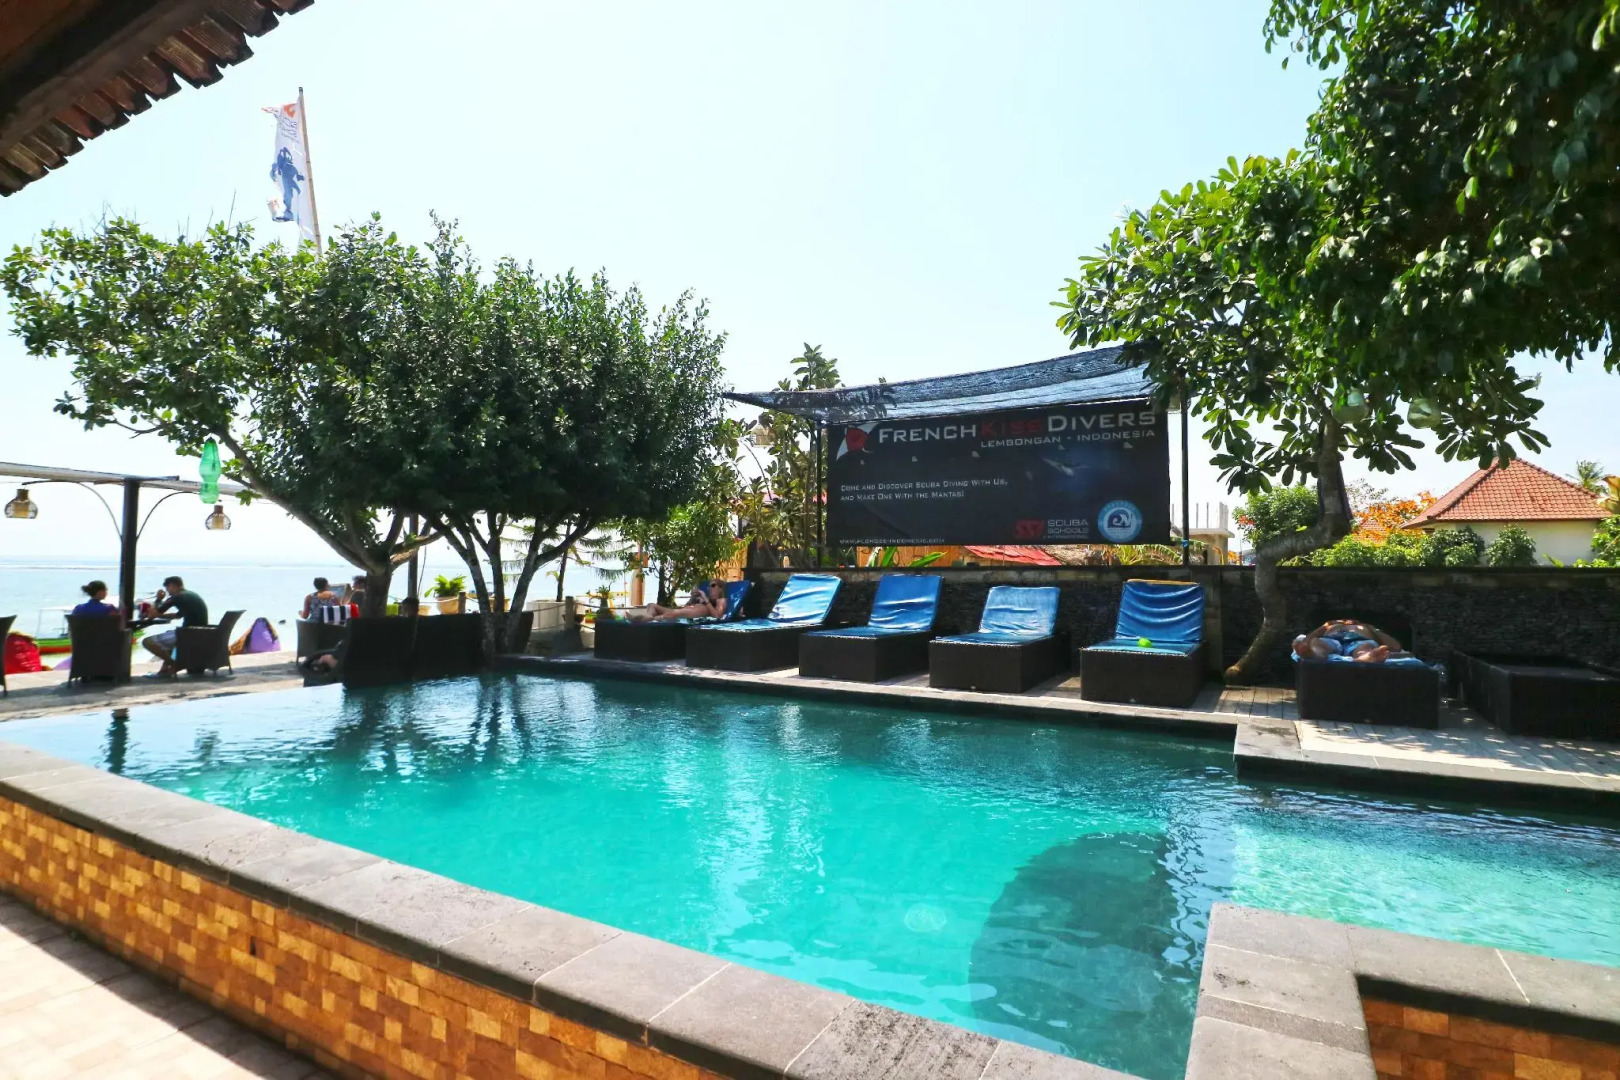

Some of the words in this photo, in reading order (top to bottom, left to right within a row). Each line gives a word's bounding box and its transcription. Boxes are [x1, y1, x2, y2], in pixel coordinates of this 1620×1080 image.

[1048, 412, 1156, 432] DIVERS
[981, 435, 1061, 448] LEMBONGAN
[1077, 430, 1155, 441] INDONESIA
[878, 482, 913, 490] DISCOVER
[915, 481, 940, 489] SCUBA
[943, 480, 968, 488] DIVING
[877, 492, 892, 500] ONE
[1047, 518, 1089, 527] SCUBA
